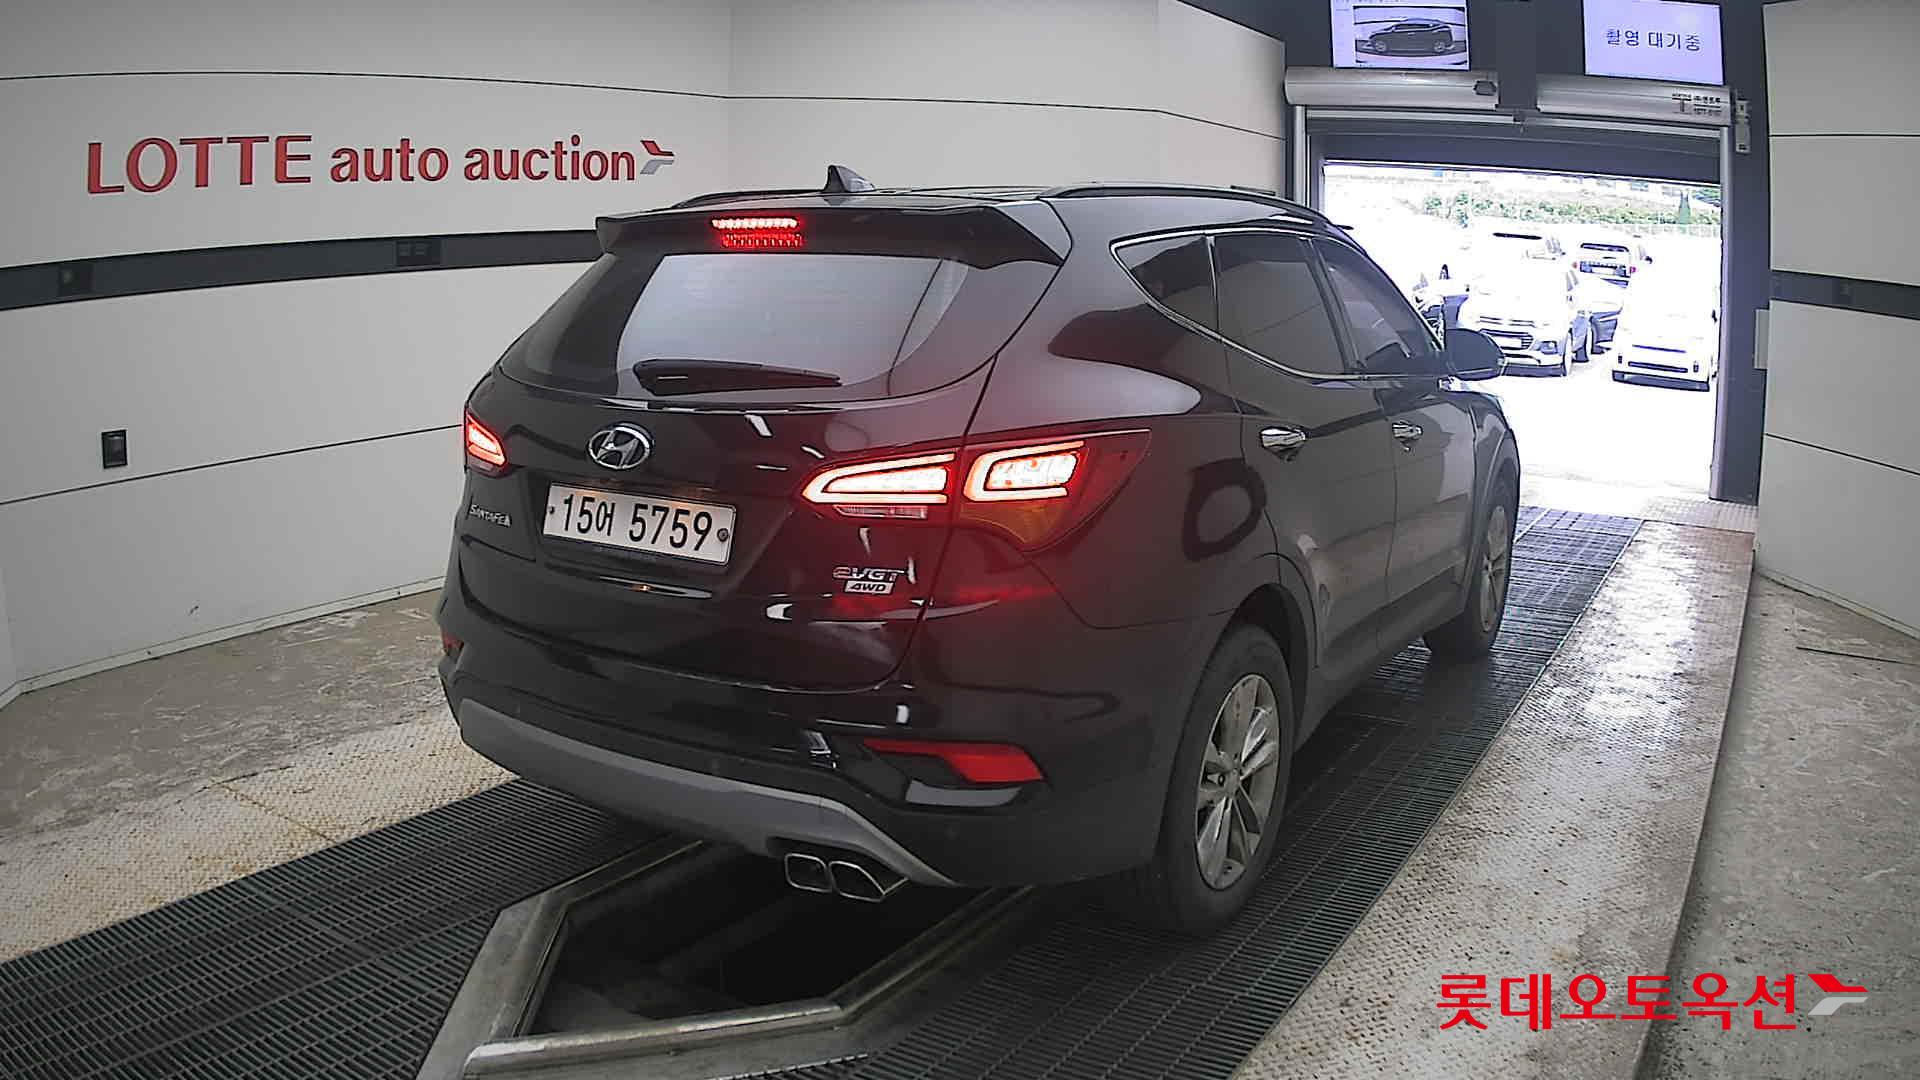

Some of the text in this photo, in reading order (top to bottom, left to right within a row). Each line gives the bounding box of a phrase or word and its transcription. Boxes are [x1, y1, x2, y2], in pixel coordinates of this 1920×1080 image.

[1606, 28, 1701, 52] 촬영 대기중
[87, 134, 637, 195] LOTTE auto auction
[563, 493, 713, 552] 15어 5759
